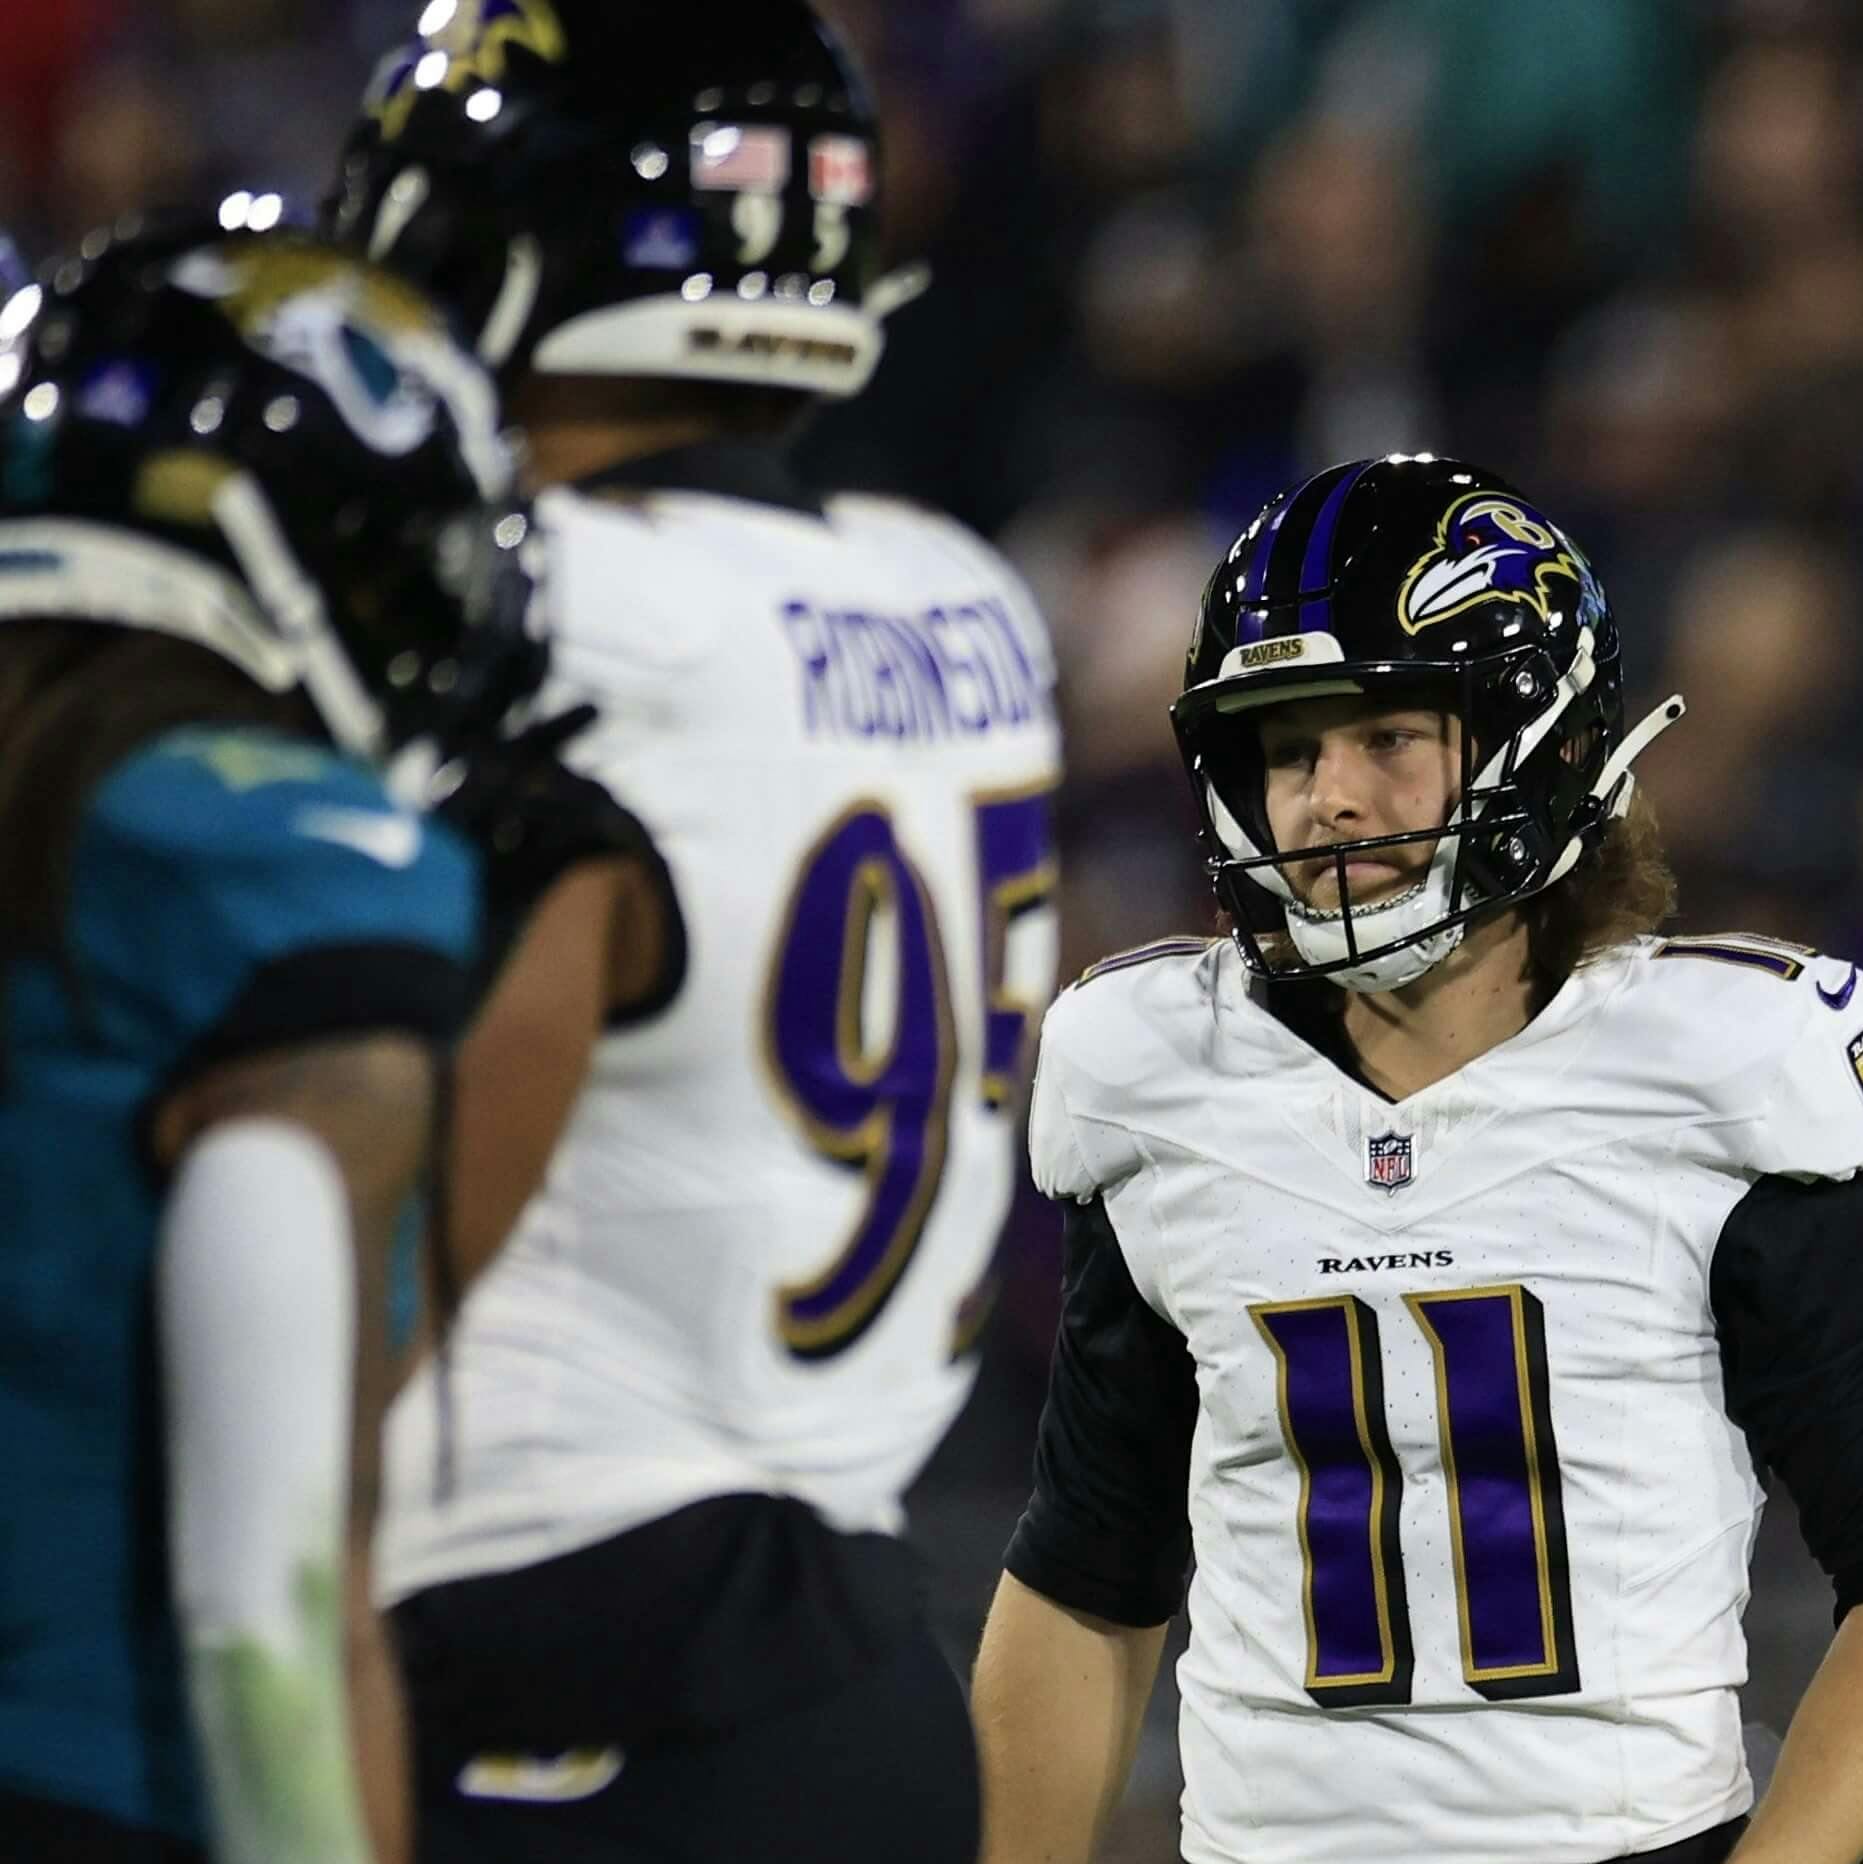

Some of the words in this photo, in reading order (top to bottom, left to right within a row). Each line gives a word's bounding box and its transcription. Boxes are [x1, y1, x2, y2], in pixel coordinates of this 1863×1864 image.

[1240, 638, 1304, 668] RAVENS
[1374, 1156, 1409, 1182] NFL
[1316, 1250, 1454, 1274] RAVENS
[1245, 1284, 1582, 1709] 11
